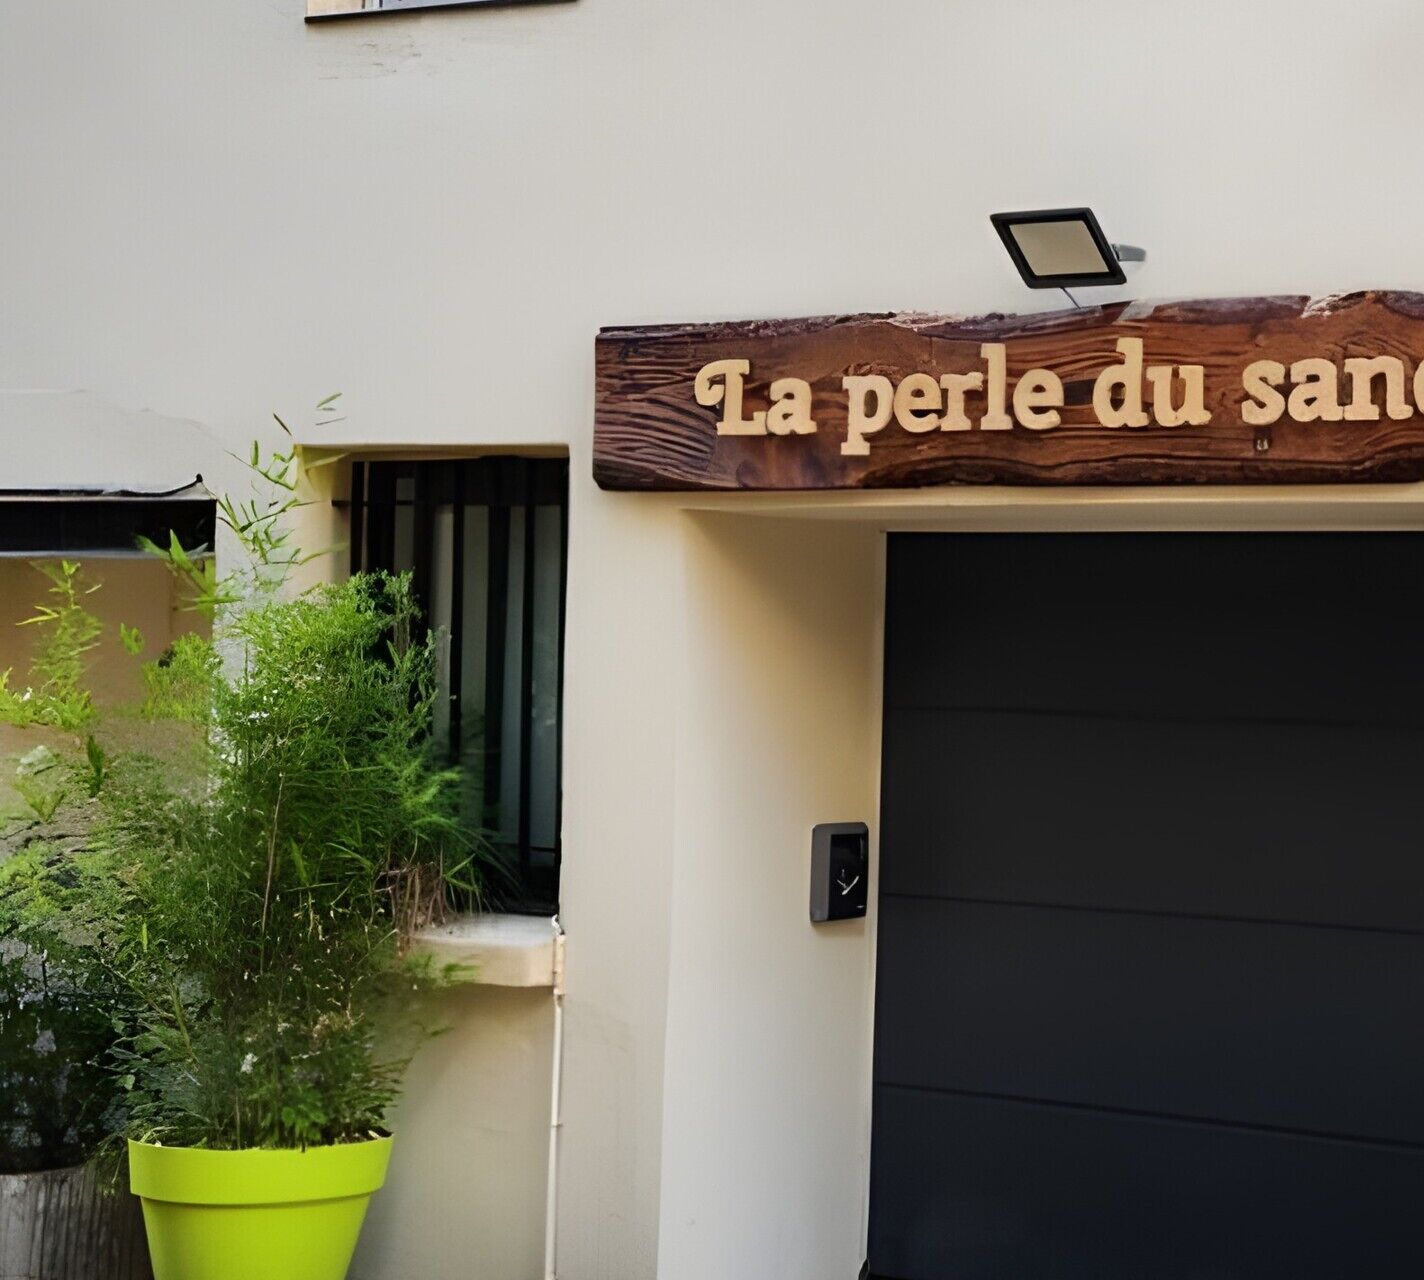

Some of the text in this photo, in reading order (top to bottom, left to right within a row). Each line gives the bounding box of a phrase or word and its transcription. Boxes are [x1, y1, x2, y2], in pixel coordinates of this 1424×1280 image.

[693, 358, 816, 436] La
[841, 344, 1063, 456] perle
[1093, 337, 1212, 430] du
